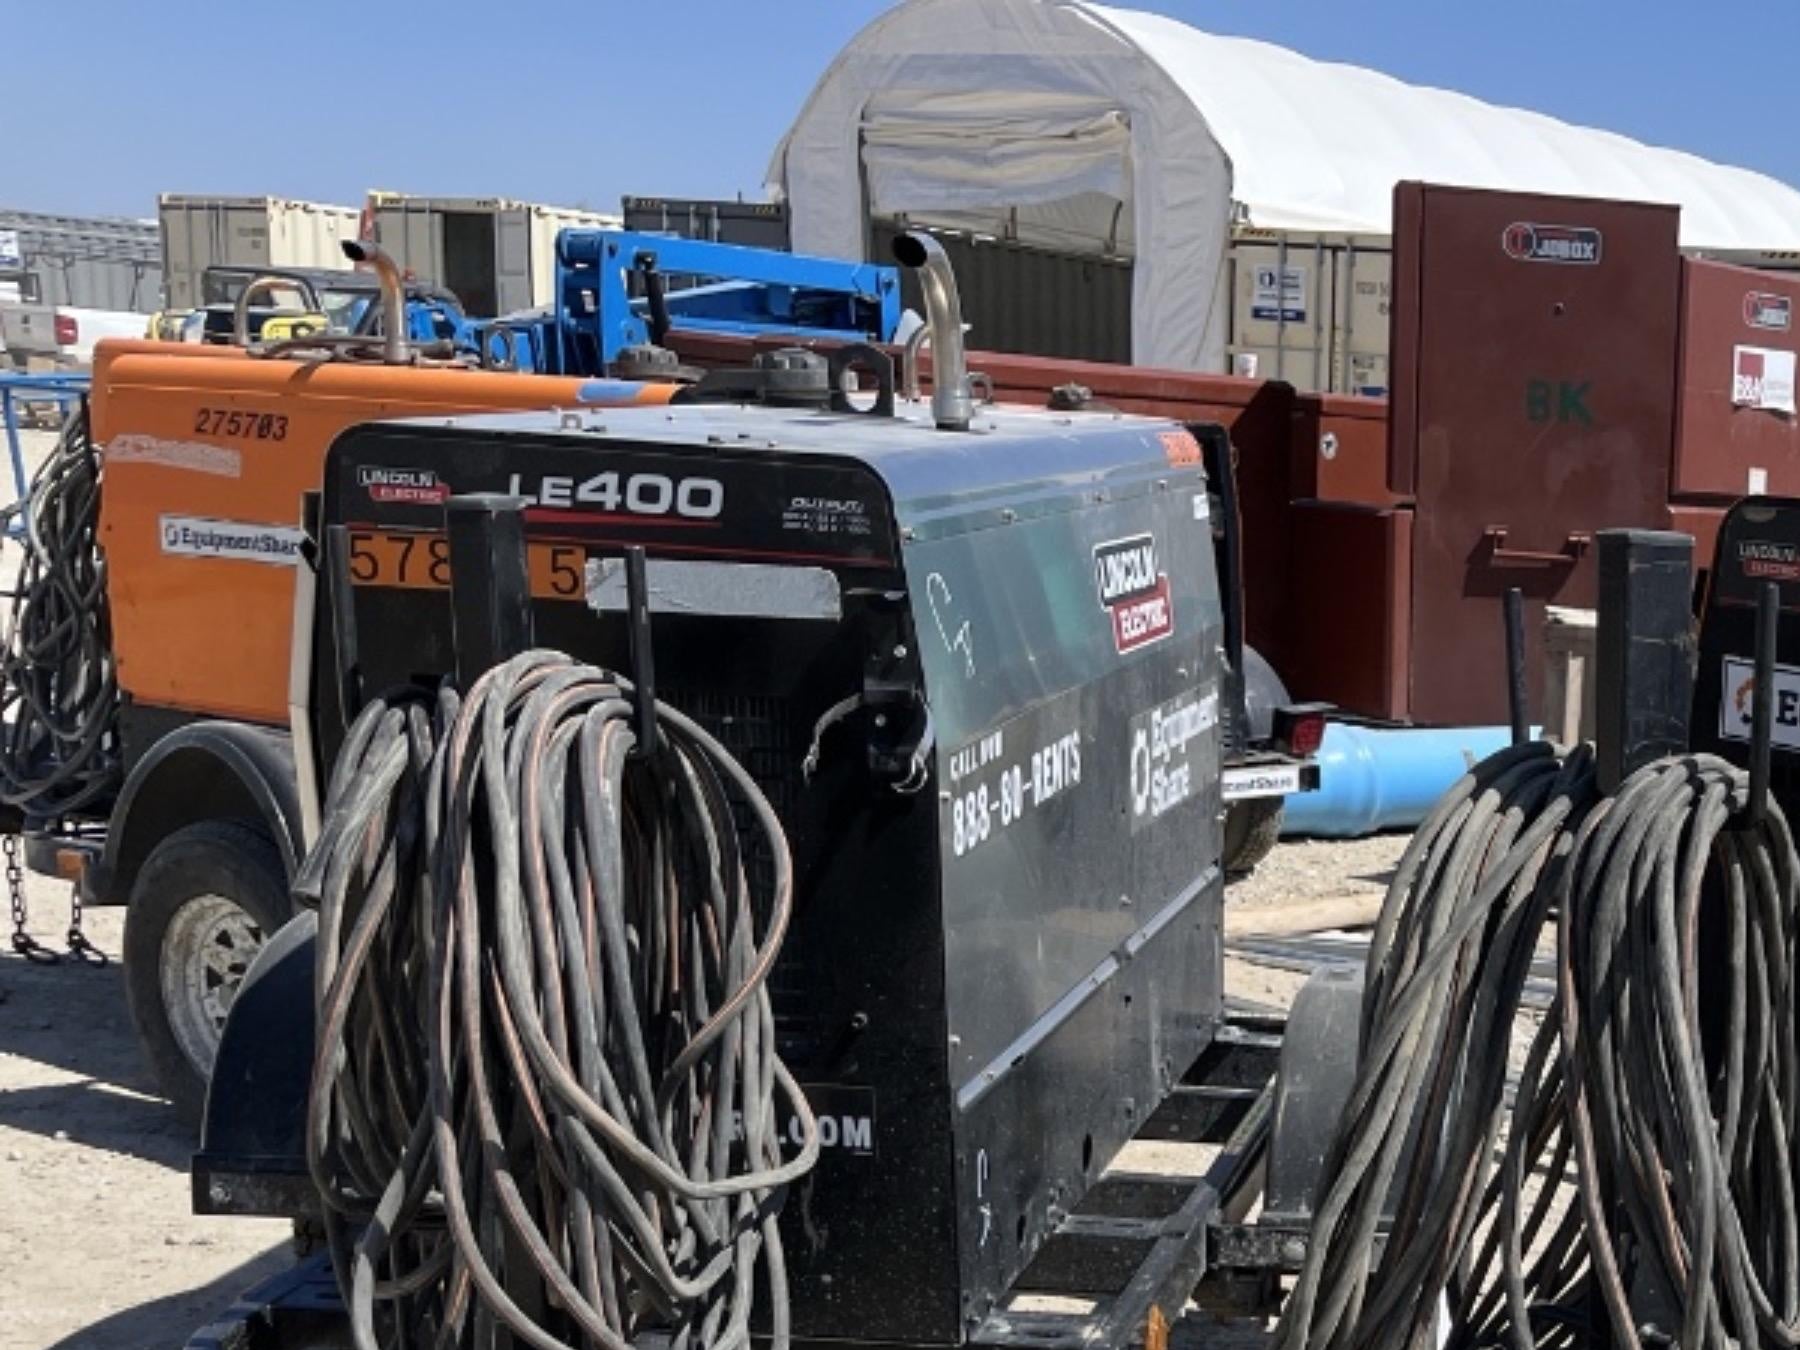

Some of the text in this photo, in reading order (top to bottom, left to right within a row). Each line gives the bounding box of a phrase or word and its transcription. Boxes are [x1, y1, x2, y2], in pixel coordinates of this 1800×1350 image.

[1527, 378, 1594, 426] BK
[194, 408, 289, 441] 275703
[360, 469, 434, 488] LINCOLN
[508, 472, 724, 518] LE400
[182, 528, 300, 554] EquipmentShar
[1739, 543, 1796, 563] LINCOLN
